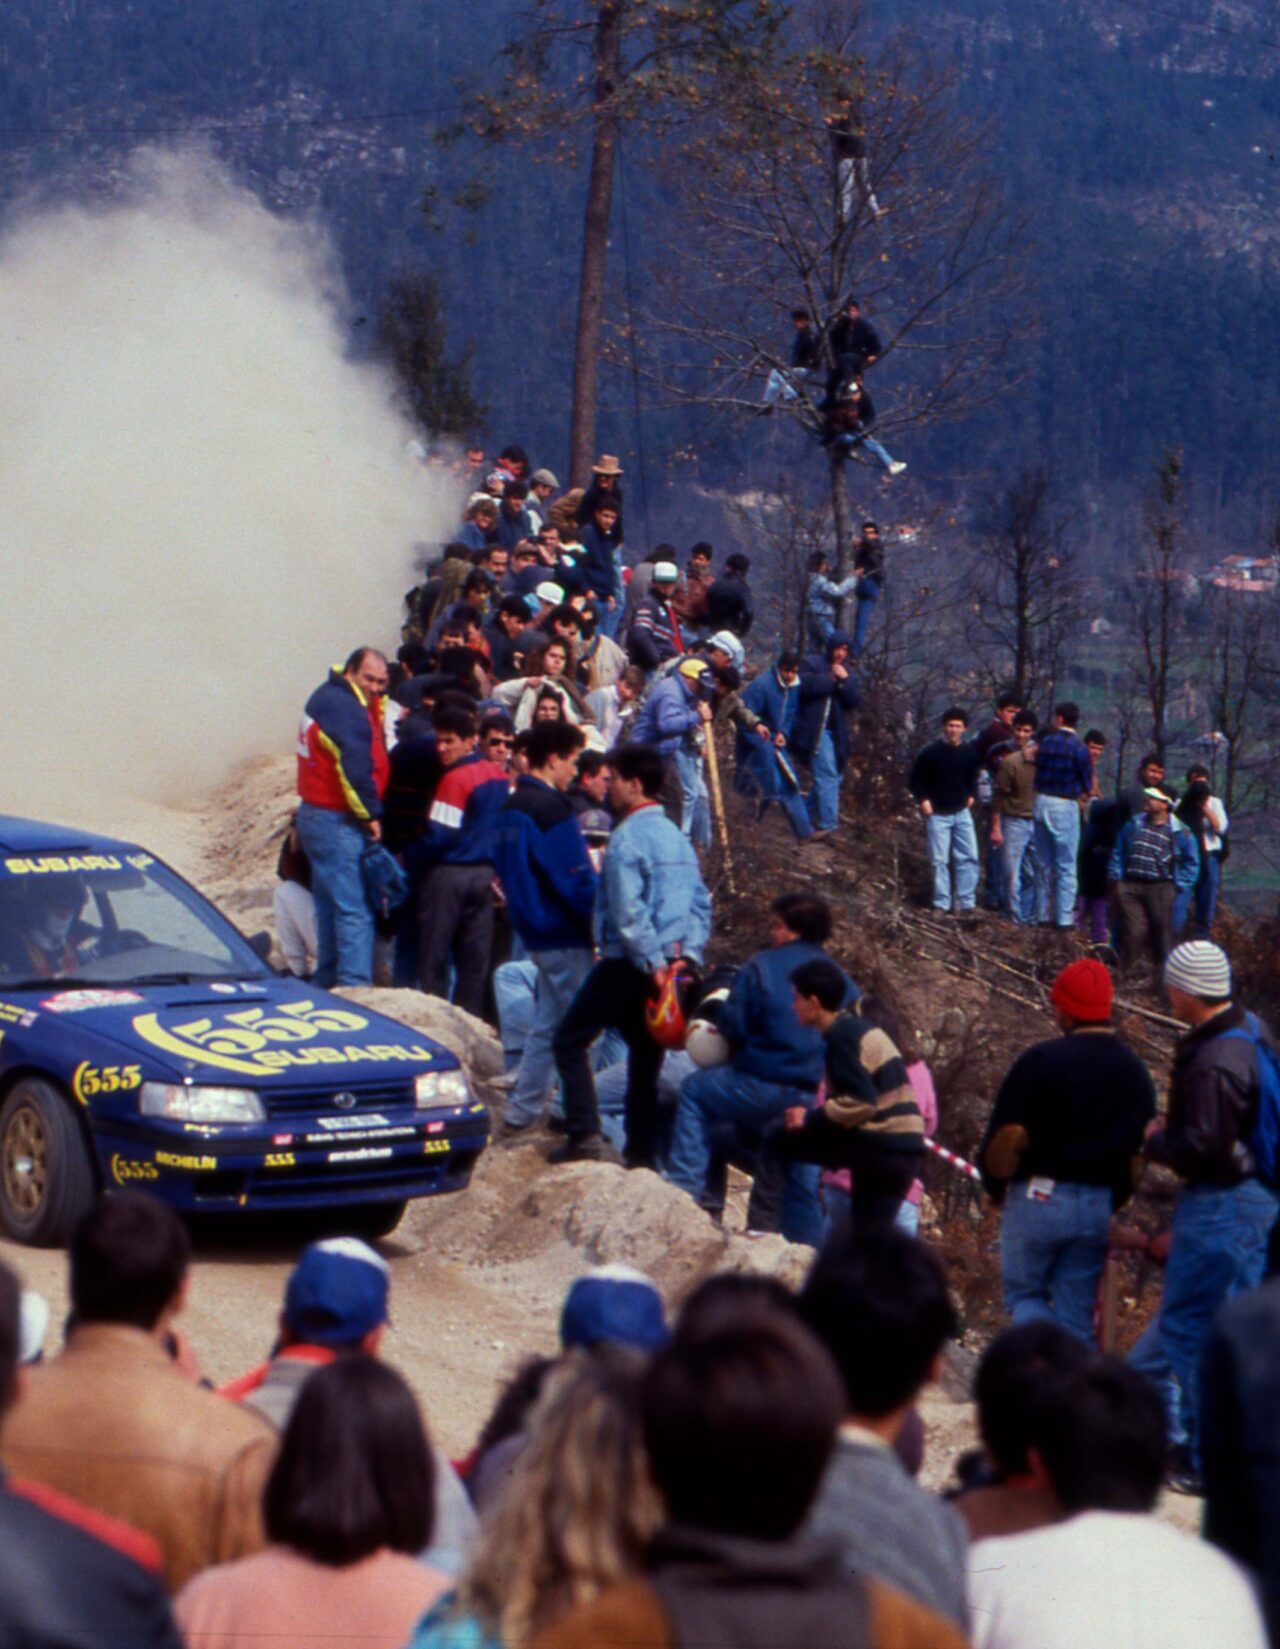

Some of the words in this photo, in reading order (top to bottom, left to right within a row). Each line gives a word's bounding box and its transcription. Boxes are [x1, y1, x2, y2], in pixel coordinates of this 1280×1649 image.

[5, 855, 122, 874] SUBARU
[251, 1045, 433, 1067] SUBARU
[82, 1064, 142, 1095] 555
[424, 1138, 451, 1154] 555
[155, 1150, 218, 1170] MICHELIN
[264, 1152, 296, 1167] 555
